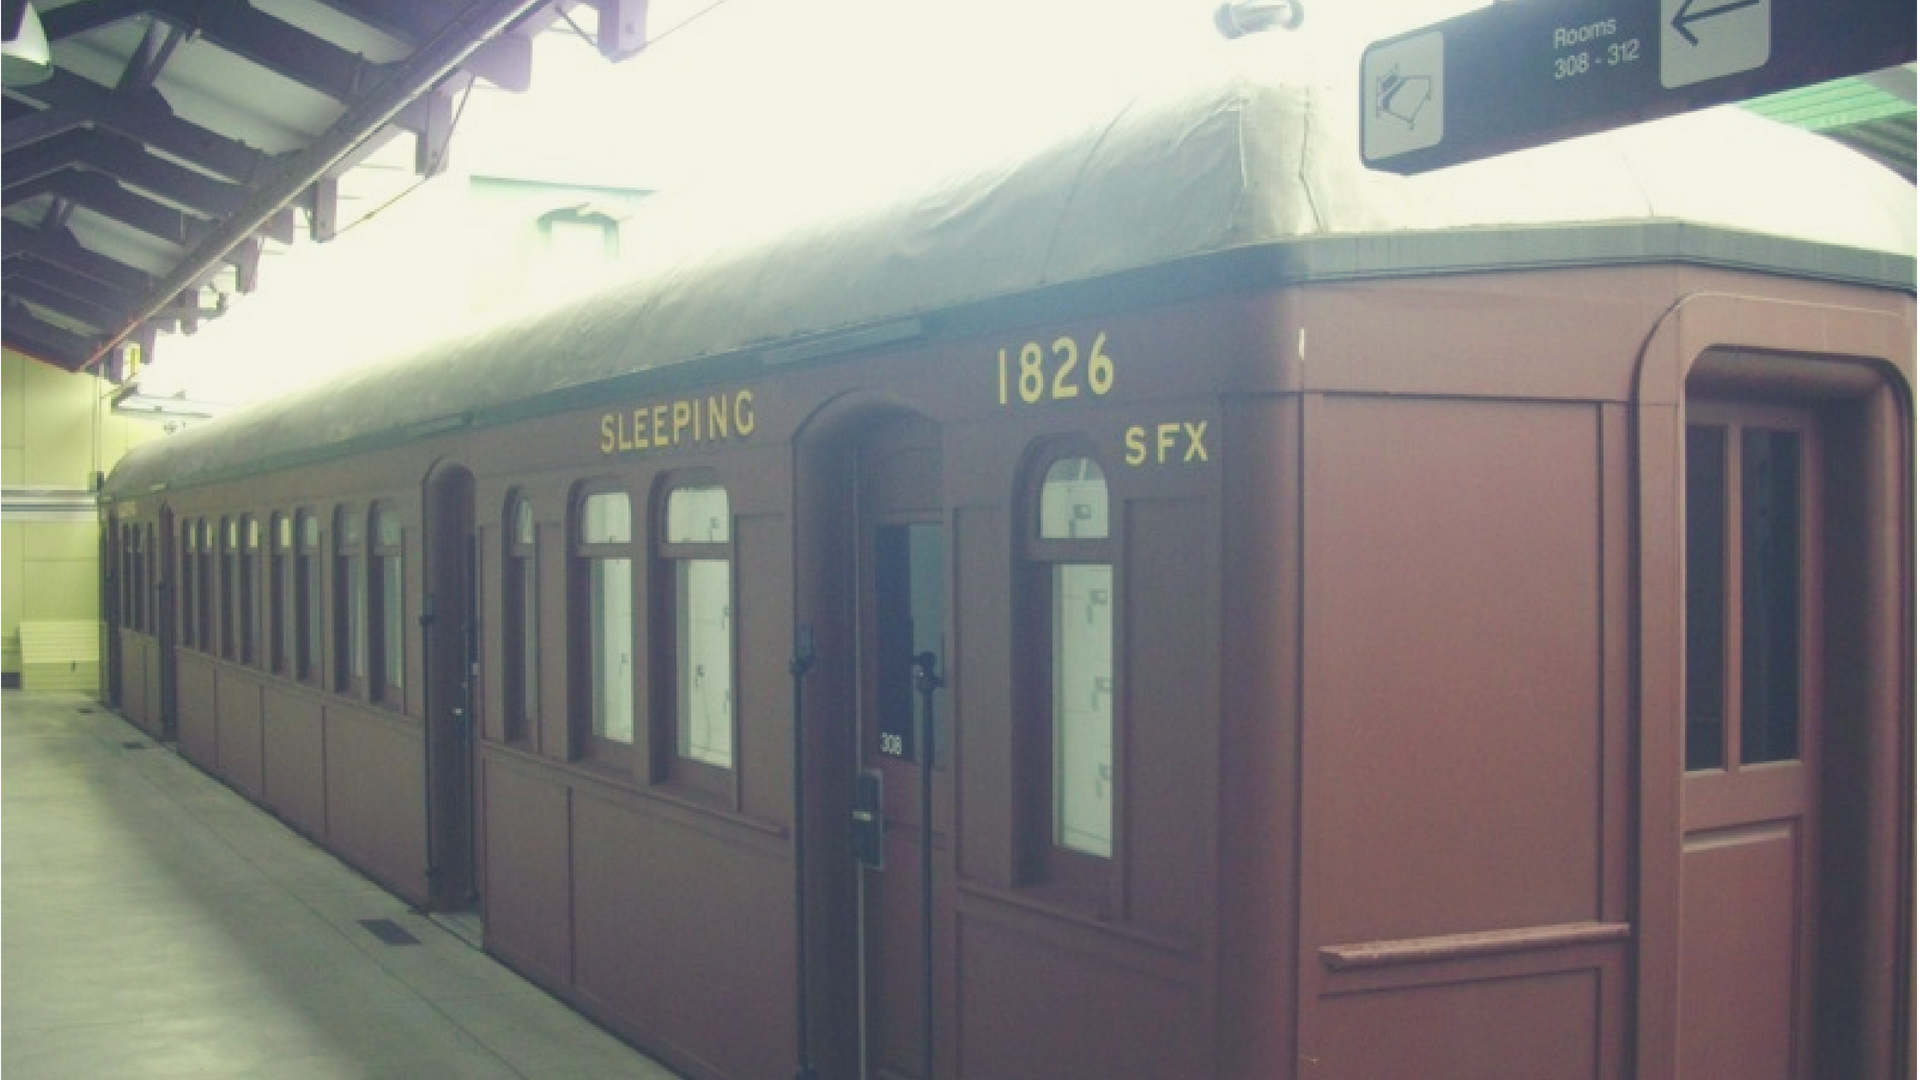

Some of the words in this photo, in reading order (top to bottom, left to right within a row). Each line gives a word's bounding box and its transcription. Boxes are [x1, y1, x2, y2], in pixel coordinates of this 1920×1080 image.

[1554, 18, 1617, 49] Rooms
[1554, 52, 1590, 79] 308
[1607, 39, 1640, 65] 312
[998, 331, 1115, 404] 1826
[601, 389, 755, 455] SLEEPING
[1125, 421, 1209, 466] SFX
[881, 732, 902, 756] 308
